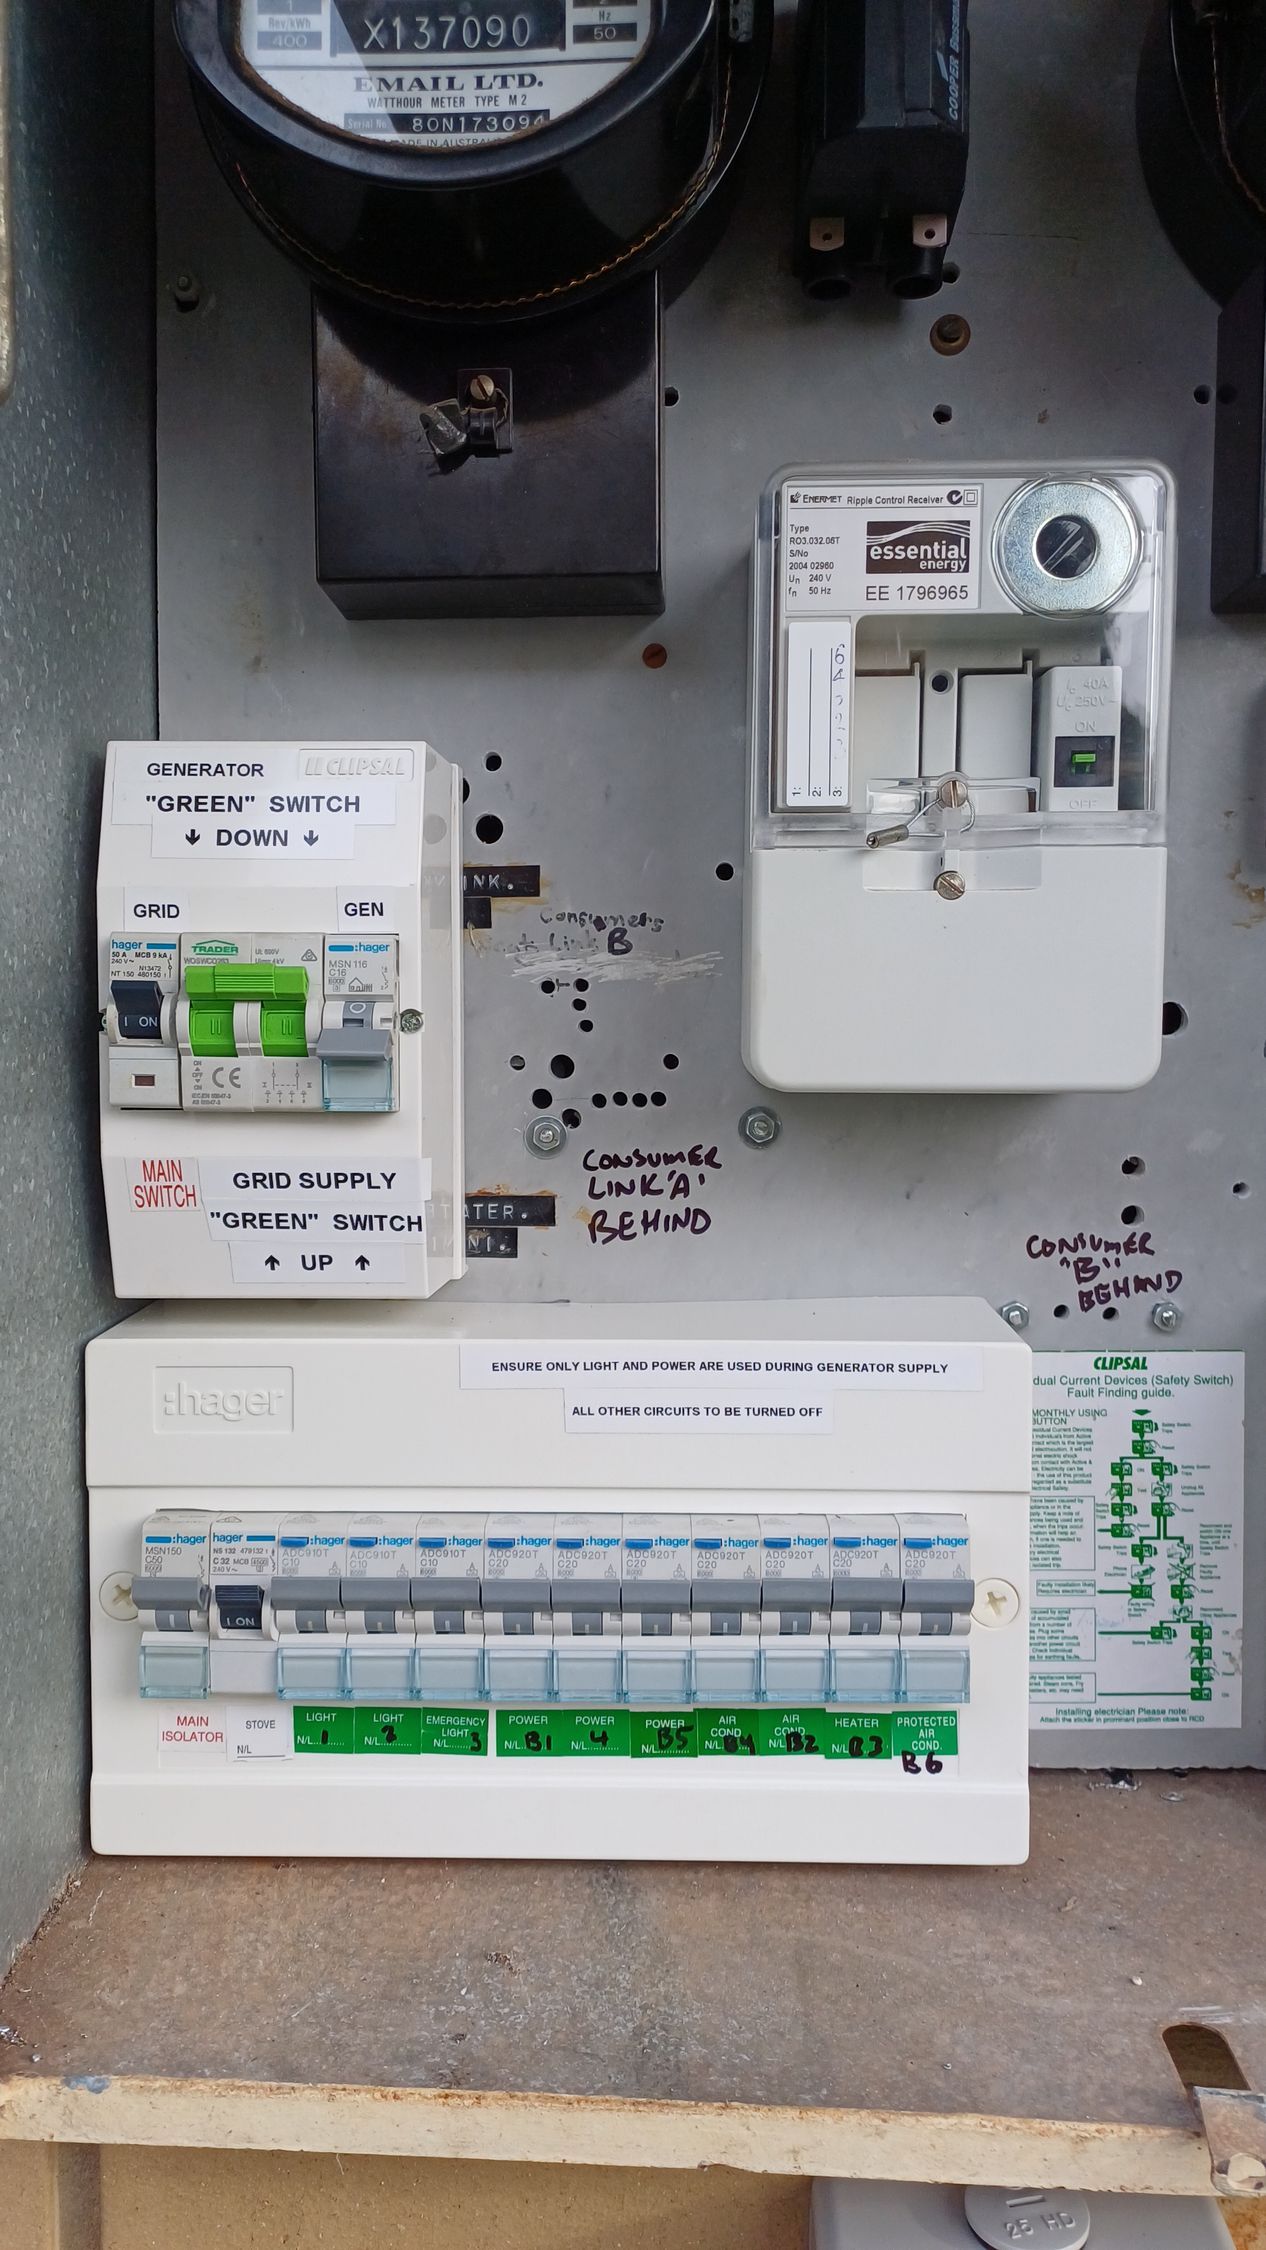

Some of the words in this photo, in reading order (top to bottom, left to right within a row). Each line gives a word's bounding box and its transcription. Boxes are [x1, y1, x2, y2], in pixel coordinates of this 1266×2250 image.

[599, 10, 612, 22] Hz
[363, 15, 531, 51] X137090
[593, 26, 617, 40] 50
[272, 35, 308, 49] 400
[353, 76, 465, 93] EMAIL
[473, 73, 544, 91] LTD.
[948, 55, 960, 121] COOPER
[367, 97, 422, 109] WATTHOUR
[431, 96, 466, 108] METER
[475, 95, 500, 107] TYPE
[520, 94, 528, 105] 2
[347, 118, 373, 130] Serial
[802, 495, 842, 504] ENERMET
[847, 496, 873, 505] Ripple
[874, 495, 905, 505] Control
[907, 495, 944, 504] Receiver
[790, 524, 809, 534] Type
[789, 550, 809, 558] S/No
[870, 538, 967, 560] essential
[789, 562, 808, 570] 2004
[919, 558, 967, 573] energy
[809, 574, 824, 582] 240
[808, 587, 819, 595] 50
[820, 587, 832, 595] Hz
[866, 586, 890, 601] EE
[896, 585, 969, 601] 1796965
[1074, 721, 1097, 733] ON
[146, 763, 265, 778] GENERATOR
[326, 755, 405, 776] CLIPSAL
[146, 795, 255, 813] "GREEN"
[268, 795, 361, 813] SWITCH
[1069, 800, 1097, 810] OFF
[215, 829, 289, 847] DOWN
[132, 903, 180, 919] GRID
[343, 901, 384, 917] GEN
[111, 939, 143, 950] hager
[607, 927, 634, 956] B
[192, 946, 239, 954] TRADER
[328, 960, 351, 969] MSN
[353, 960, 368, 968] 116
[328, 969, 347, 977] C16
[138, 1015, 158, 1027] ON
[582, 1144, 723, 1173] CONSUMER
[142, 1159, 183, 1183] MAIN
[232, 1171, 292, 1190] GRID
[298, 1171, 397, 1190] SUPPLY
[588, 1173, 664, 1200] LINK
[134, 1184, 197, 1209] SWITCH
[210, 1211, 319, 1230] "GREEN"
[332, 1213, 423, 1232] SWITCH
[588, 1207, 712, 1245] BEHIND
[1026, 1232, 1156, 1259] CONSUMER
[301, 1254, 334, 1271] UP
[1077, 1270, 1183, 1313] BEHIND
[491, 1362, 543, 1372] ENSURE
[546, 1362, 580, 1372] ONLY
[583, 1361, 619, 1371] LIGHT
[622, 1361, 648, 1371] AND
[651, 1361, 696, 1371] POWER
[699, 1361, 724, 1371] ARE
[727, 1361, 762, 1372] USED
[765, 1362, 814, 1372] DURING
[816, 1362, 895, 1373] GENERATOR
[898, 1363, 949, 1374] SUPPLY
[1094, 1356, 1148, 1371] CLIPSAL
[1059, 1375, 1101, 1386] Current
[1104, 1374, 1148, 1386] Devices
[1151, 1374, 1190, 1387] (Safety
[1193, 1373, 1234, 1386] Switch)
[1067, 1388, 1094, 1398] Fault
[1097, 1387, 1138, 1400] Finding
[1141, 1388, 1175, 1400] guide.
[572, 1406, 595, 1416] ALL
[598, 1406, 640, 1416] OTHER
[643, 1406, 701, 1417] CIRCUITS
[703, 1407, 720, 1416] TO
[724, 1407, 741, 1417] BE
[744, 1406, 796, 1417] TURNED
[798, 1407, 823, 1417] OFF
[1032, 1408, 1076, 1417] MONTHLY
[1078, 1408, 1108, 1417] USING
[212, 1532, 243, 1544] hager
[145, 1547, 182, 1556] MSN150
[282, 1549, 329, 1558] ADC910T
[350, 1551, 397, 1560] ADC910T
[420, 1549, 466, 1558] ADC910T
[488, 1550, 539, 1559] ADC920T
[904, 1551, 957, 1560] ADC920T
[145, 1556, 163, 1564] C50
[220, 1557, 230, 1565] 32
[282, 1558, 300, 1566] C10
[350, 1560, 368, 1568] C10
[420, 1558, 439, 1567] C10
[488, 1559, 509, 1568] C20
[904, 1560, 926, 1568] C20
[235, 1617, 255, 1626] ON
[306, 1712, 337, 1723] LIGHT
[1055, 1707, 1092, 1717] Installing
[1094, 1707, 1135, 1716] electrician
[1137, 1707, 1166, 1716] Please
[176, 1715, 210, 1727] MAIN
[373, 1713, 404, 1724] LIGHT
[426, 1715, 486, 1727] EMERGENCY
[508, 1715, 548, 1725] POWER
[575, 1715, 615, 1726] POWER
[645, 1718, 685, 1729] POWER
[718, 1715, 737, 1725] AIR
[782, 1714, 800, 1724] AIR
[834, 1718, 879, 1729] HEATER
[896, 1716, 956, 1728] PROTECTED
[245, 1719, 276, 1730] STOVE
[161, 1731, 224, 1743] ISOLATOR
[441, 1727, 470, 1738] LIGHT
[710, 1727, 742, 1738] COND
[774, 1726, 806, 1737] COND
[918, 1728, 935, 1739] AIR
[469, 1731, 482, 1752] 3
[589, 1730, 609, 1748] 4
[237, 1744, 252, 1755] N/L
[911, 1740, 943, 1751] COND.
[1005, 2218, 1035, 2240] 25
[1040, 2212, 1077, 2231] HD
